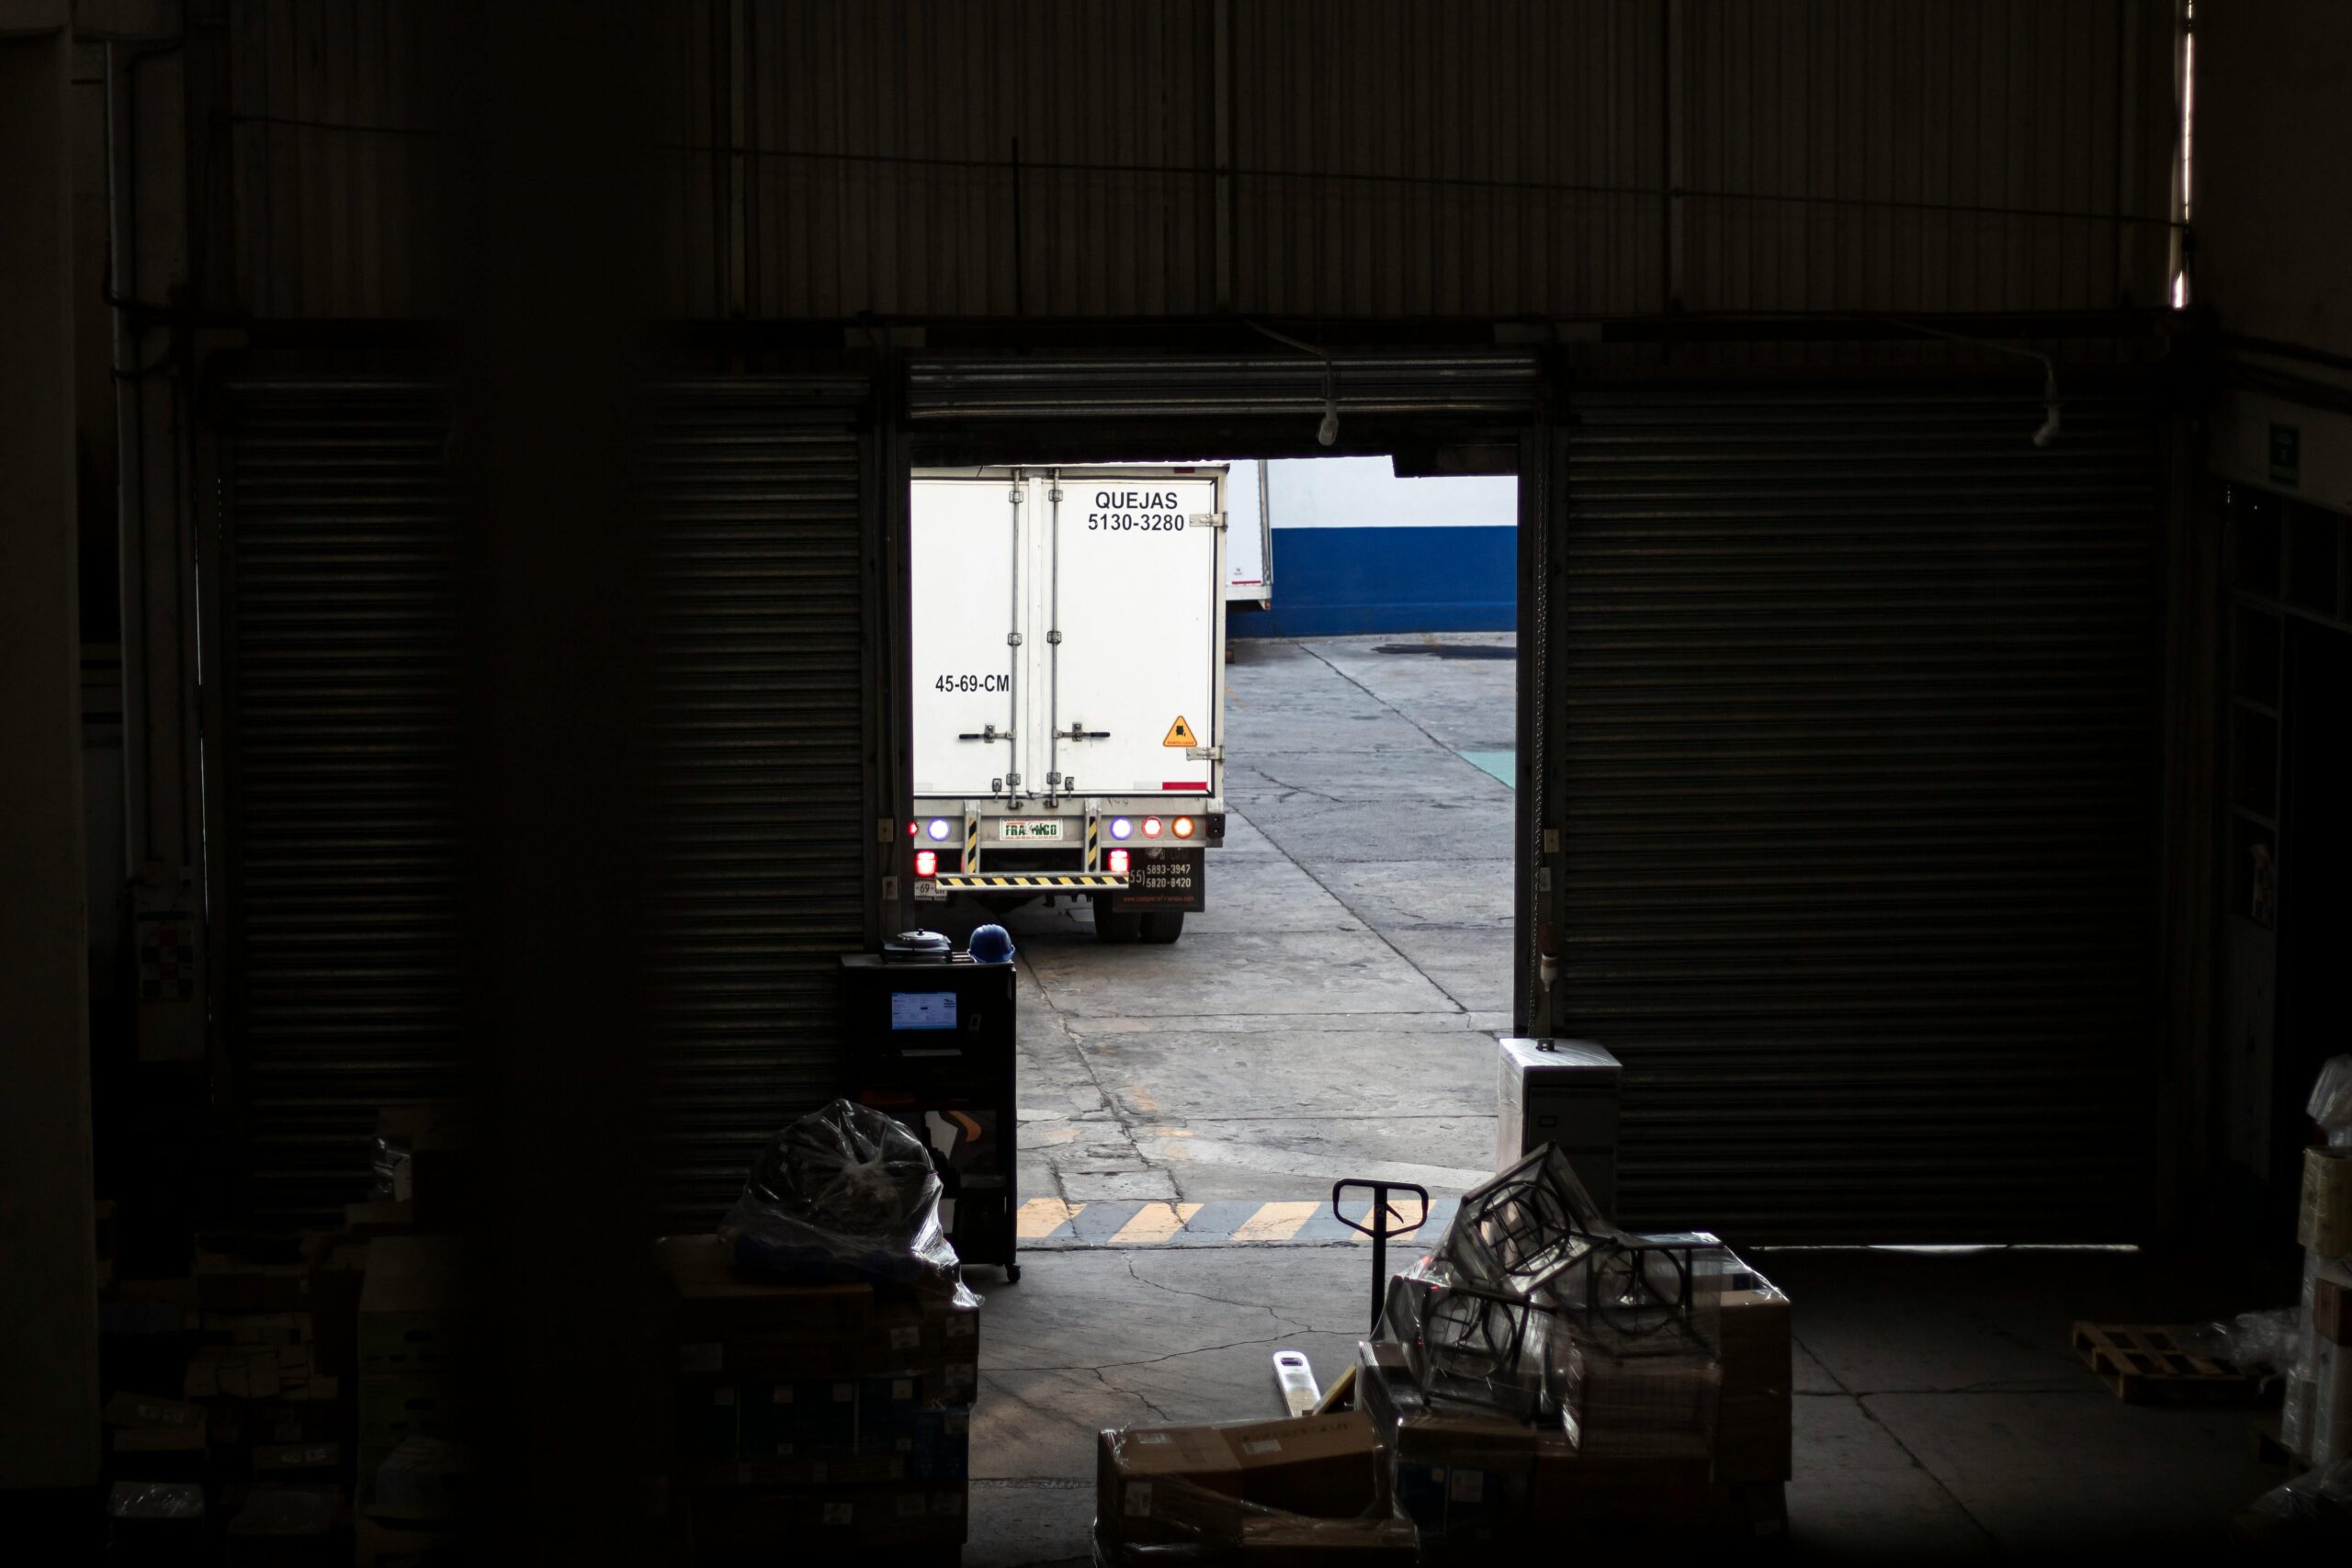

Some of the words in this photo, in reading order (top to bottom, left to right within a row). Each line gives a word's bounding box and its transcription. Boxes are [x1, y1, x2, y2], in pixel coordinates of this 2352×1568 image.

[1095, 491, 1178, 510] QUEJAS
[1088, 513, 1184, 531] 5130-3280
[935, 674, 1010, 693] 45-69-CM
[1146, 864, 1192, 874] 5893-3947
[1146, 877, 1192, 888] 5820-8420
